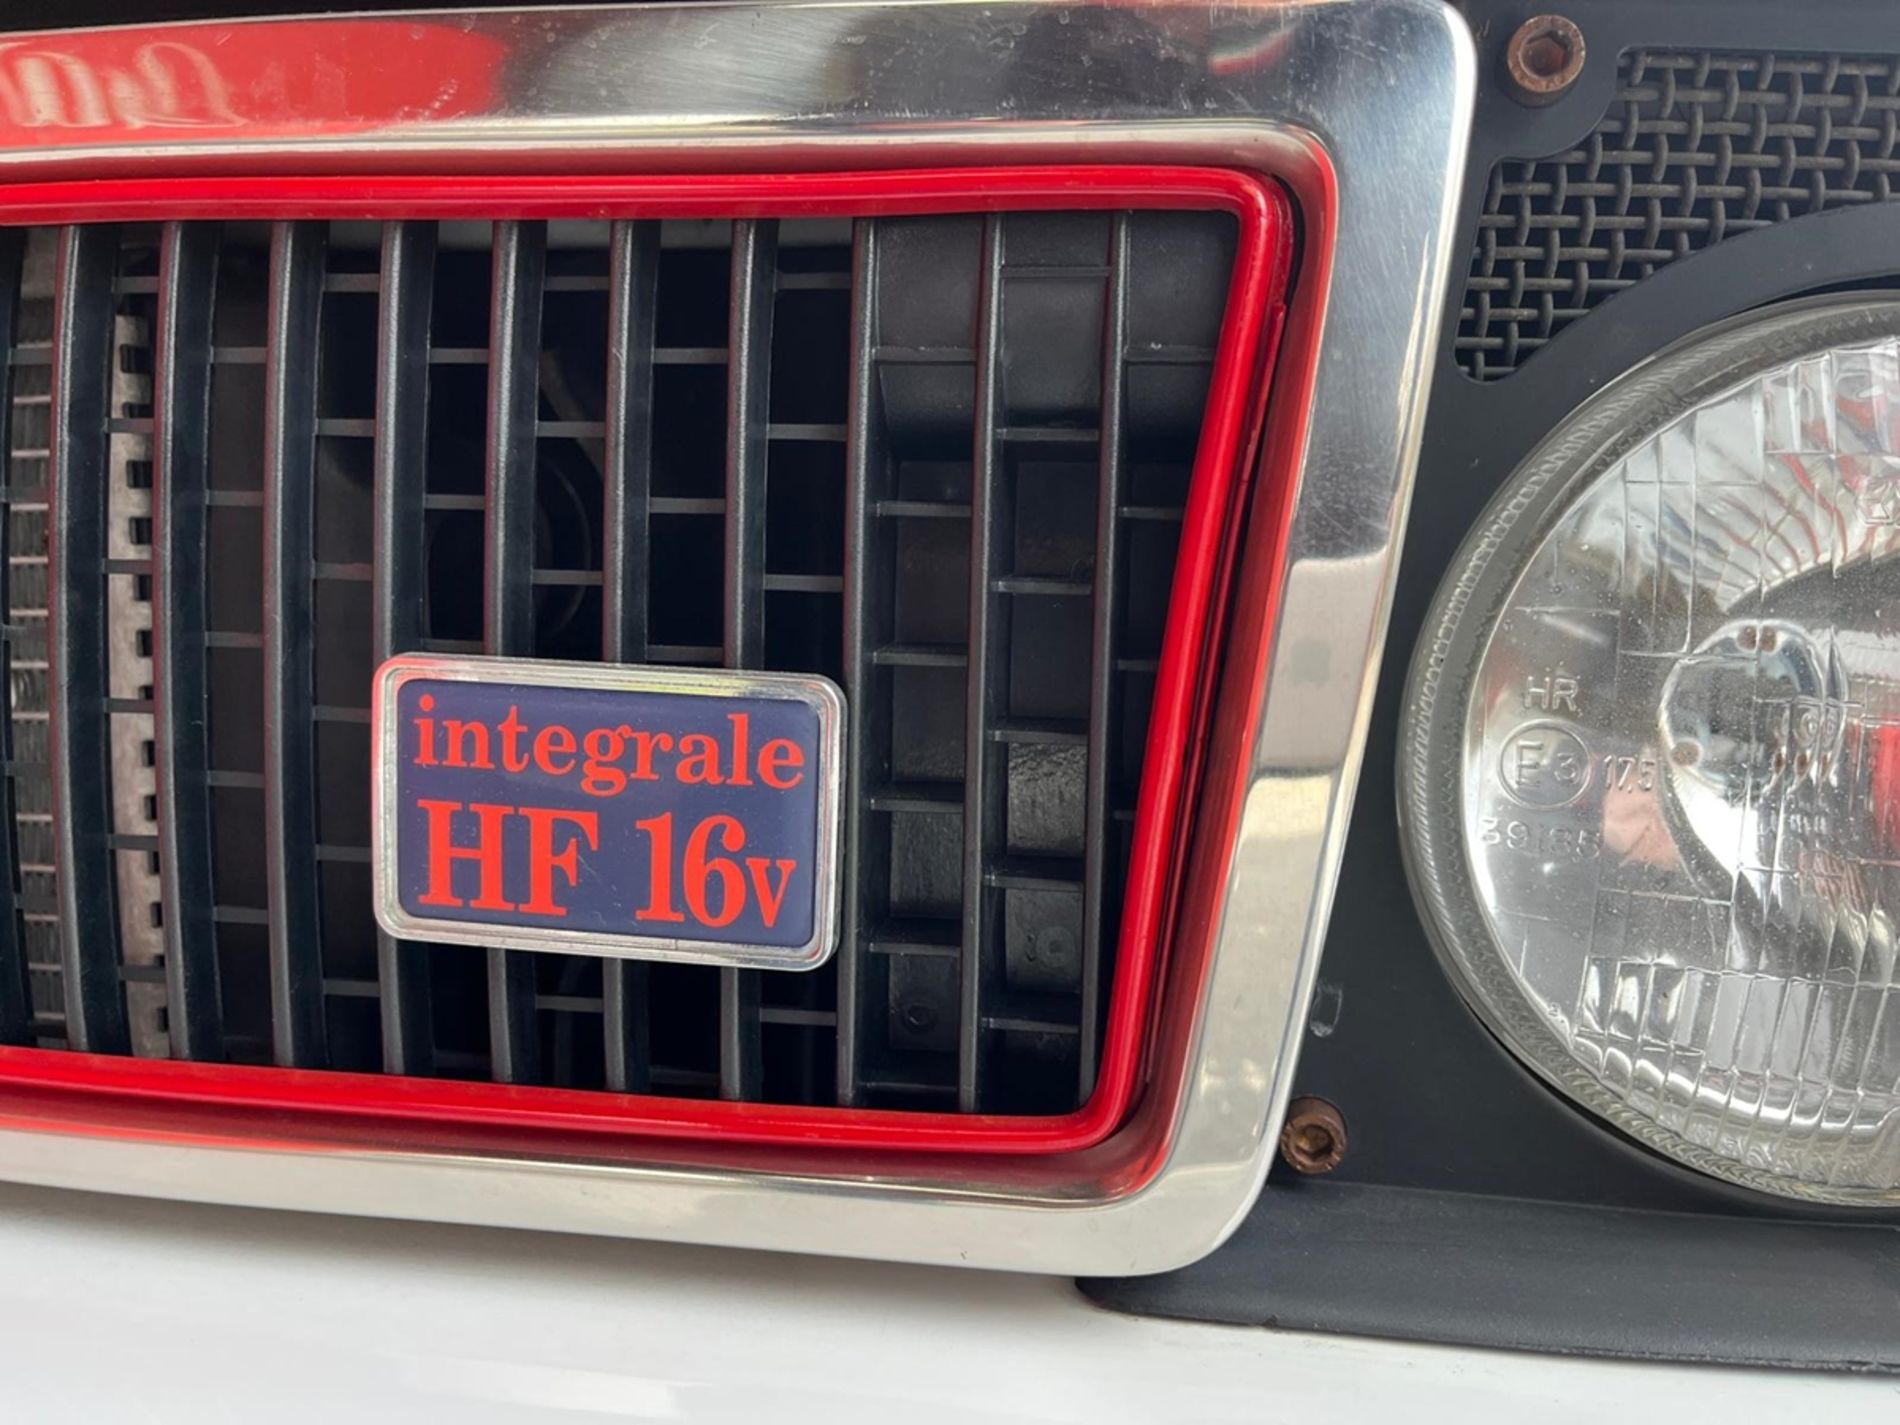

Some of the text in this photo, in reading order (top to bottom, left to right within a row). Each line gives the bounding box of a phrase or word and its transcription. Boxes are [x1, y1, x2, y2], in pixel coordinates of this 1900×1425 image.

[1523, 675, 1580, 712] HR
[414, 694, 804, 797] integrale
[417, 799, 797, 929] HF 16v
